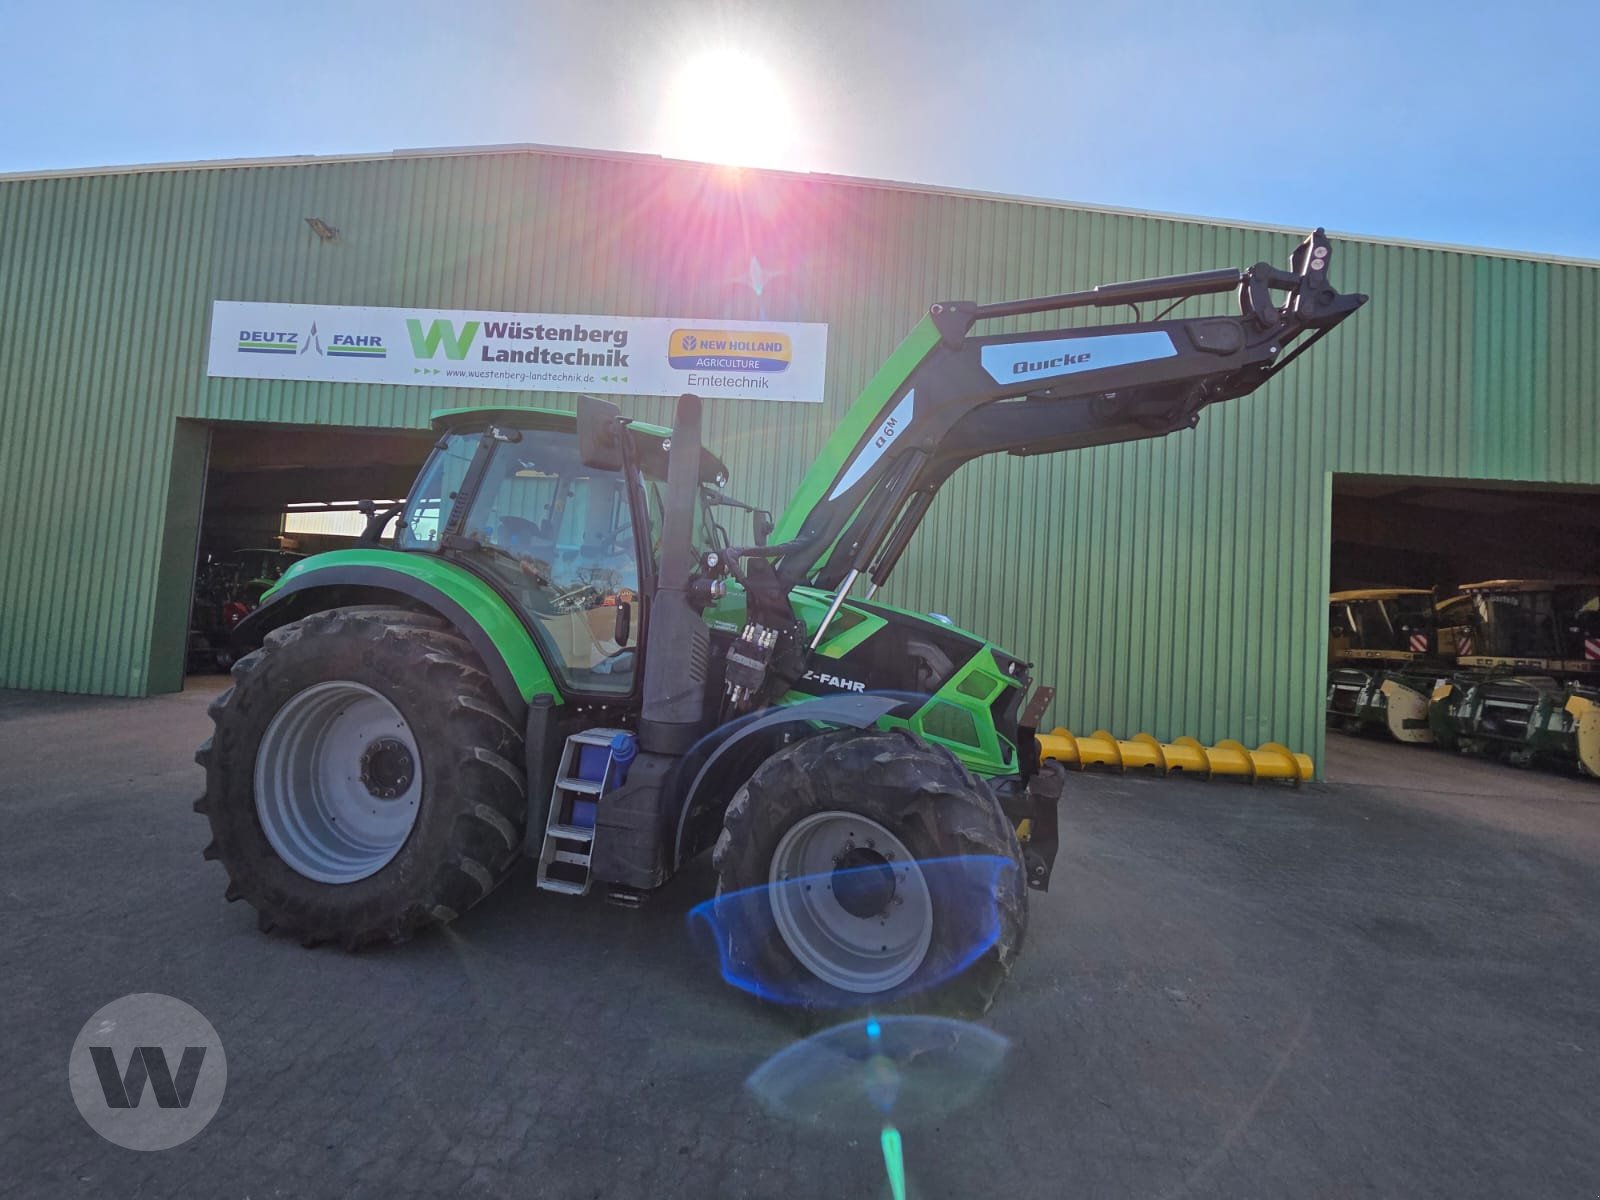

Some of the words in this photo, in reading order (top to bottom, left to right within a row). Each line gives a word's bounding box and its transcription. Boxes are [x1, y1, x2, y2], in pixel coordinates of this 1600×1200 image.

[239, 330, 298, 343] DEUTZ
[333, 334, 382, 347] FAHR
[406, 318, 480, 361] W
[484, 322, 629, 348] Wüstenberg
[700, 339, 726, 352] NEW
[728, 340, 783, 353] HOLLAND
[481, 345, 630, 368] Landtechnik
[696, 357, 760, 369] AGRICULTURE
[1012, 352, 1091, 375] Quicke
[446, 368, 595, 384] www.wuestenberg-landtechnik.de
[687, 373, 769, 389] Erntetechnik
